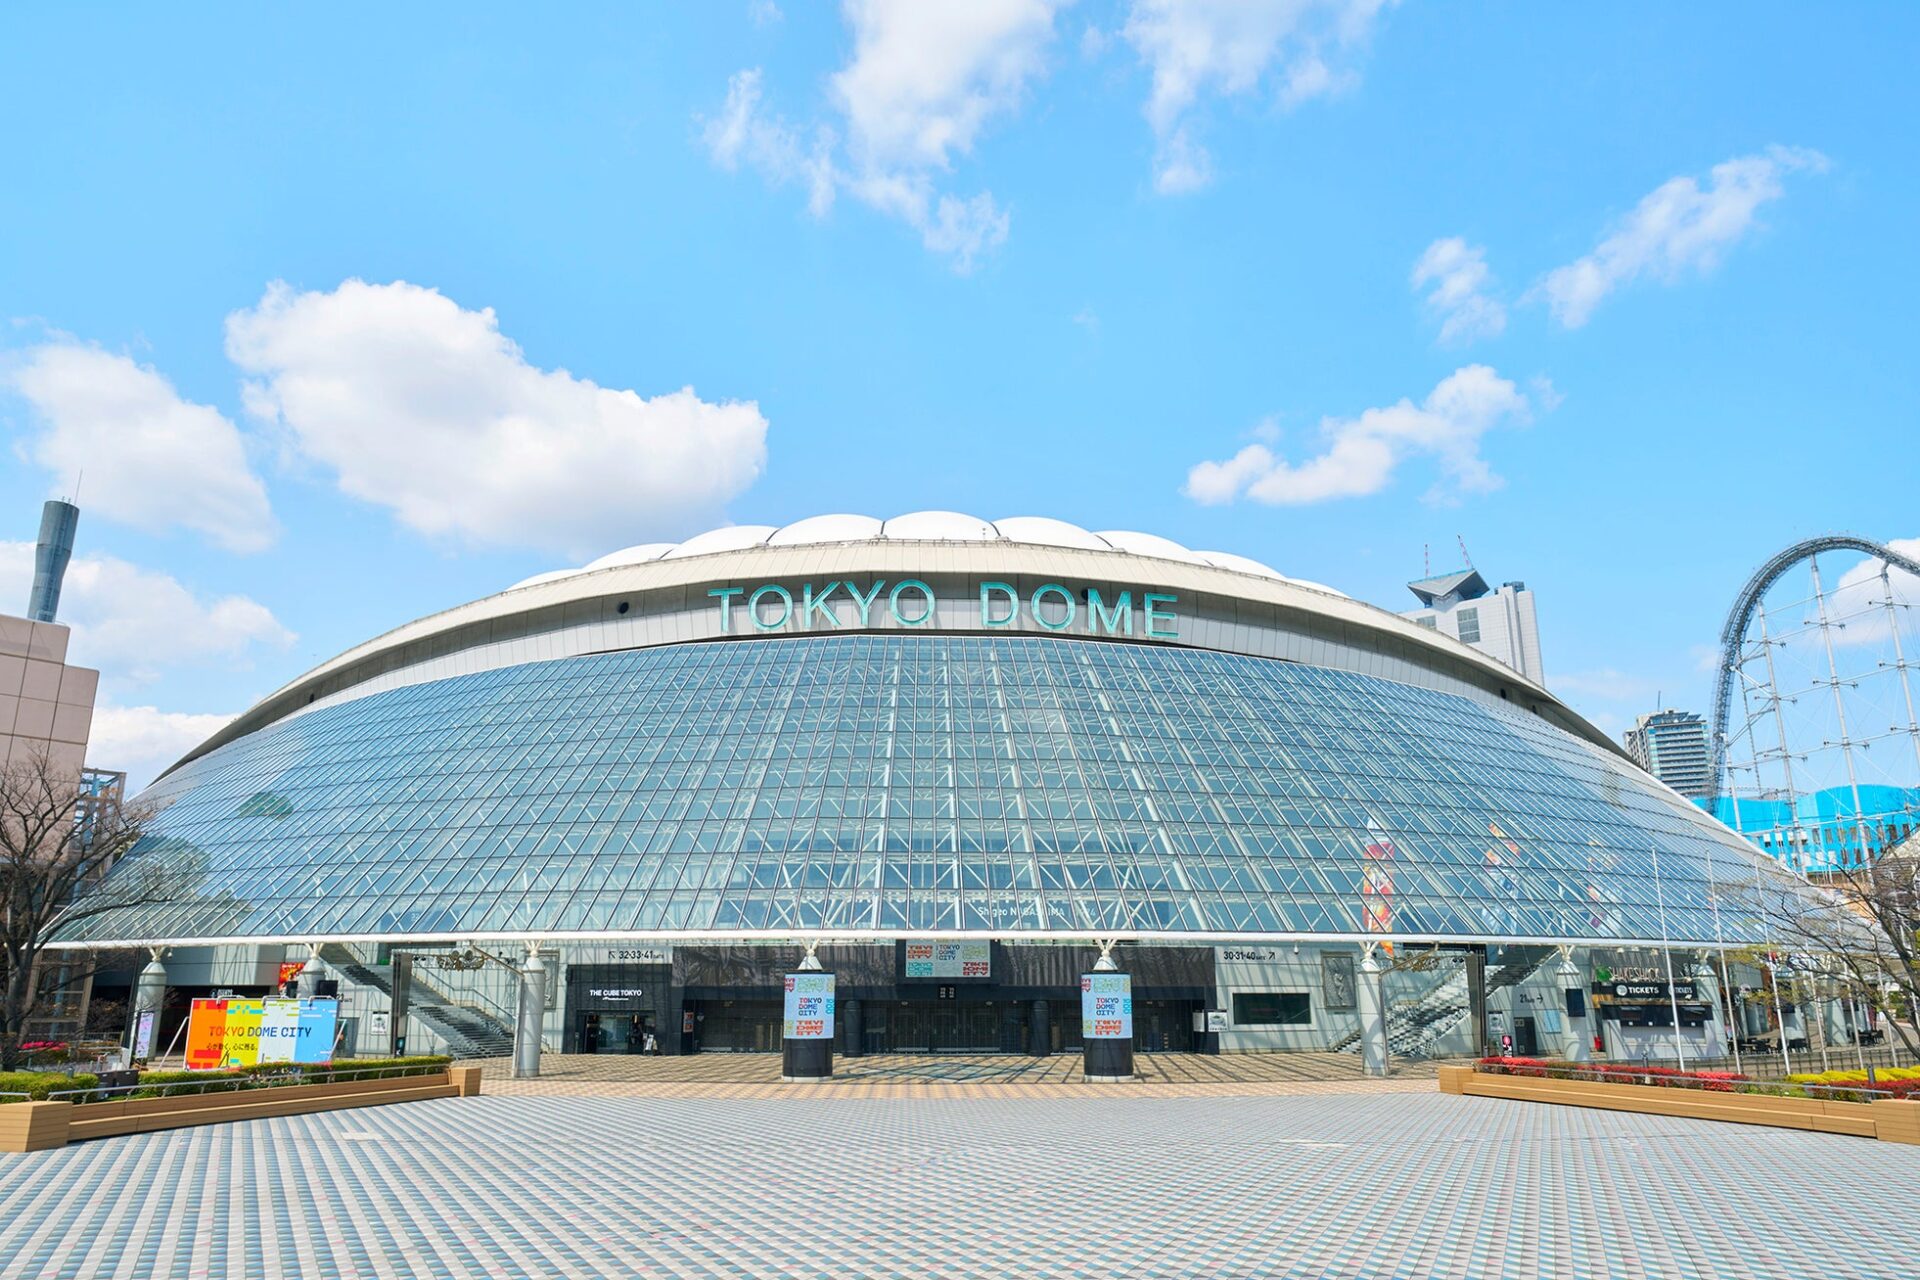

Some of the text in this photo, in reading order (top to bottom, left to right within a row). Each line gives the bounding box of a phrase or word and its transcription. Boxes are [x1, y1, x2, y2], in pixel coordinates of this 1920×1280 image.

[708, 578, 1179, 638] TOKYO DOME
[589, 989, 642, 997] THE CUBE TOKYO
[1628, 986, 1659, 994] TICKETS
[209, 1026, 312, 1038] TOKYO DOME CITY
